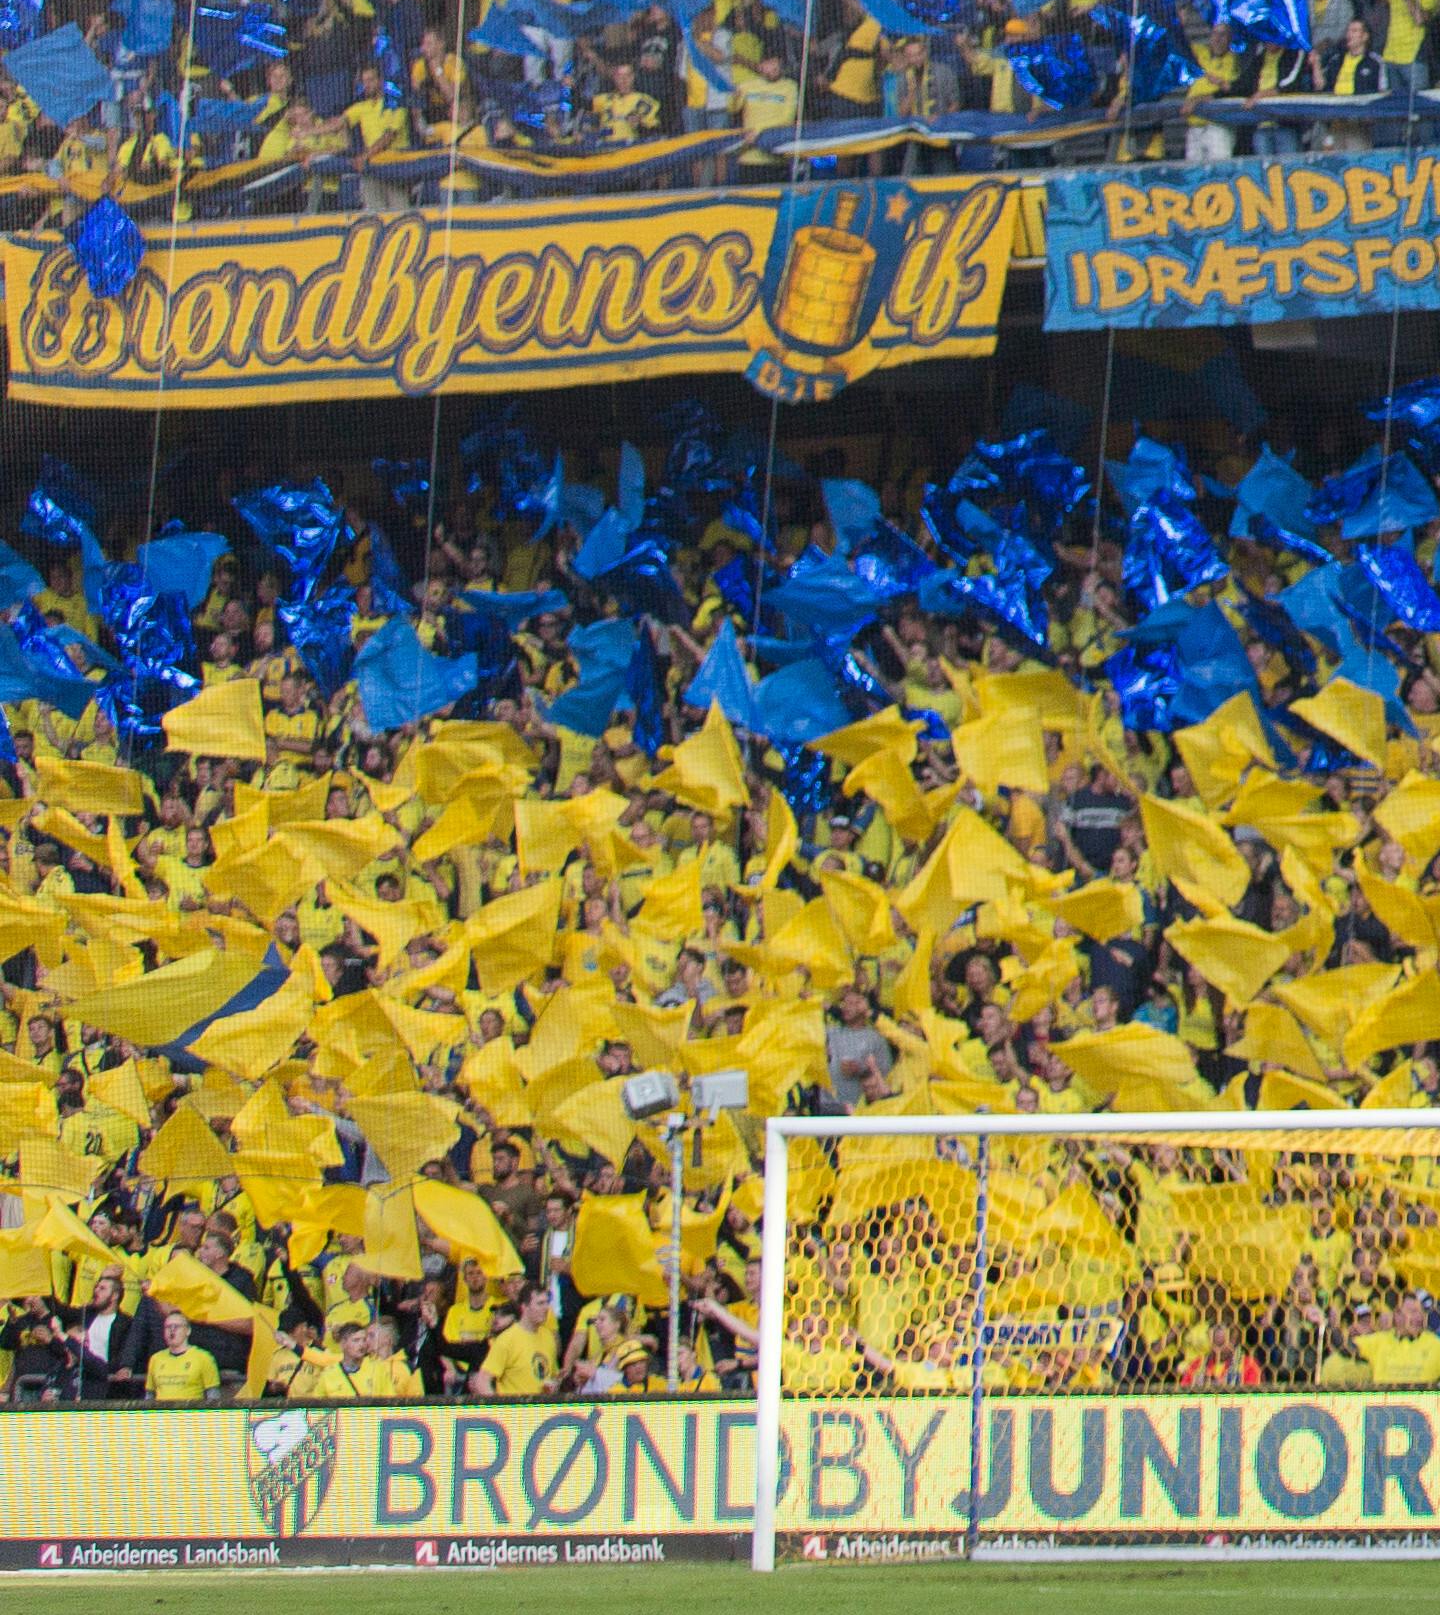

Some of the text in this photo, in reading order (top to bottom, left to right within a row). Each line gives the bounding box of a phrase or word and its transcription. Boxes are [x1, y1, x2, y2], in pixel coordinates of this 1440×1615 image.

[71, 1542, 178, 1566] Arbejdernes
[186, 1542, 280, 1565] Landsbank
[448, 1538, 558, 1567] Arbejdernes
[565, 1537, 665, 1563] Landsbank
